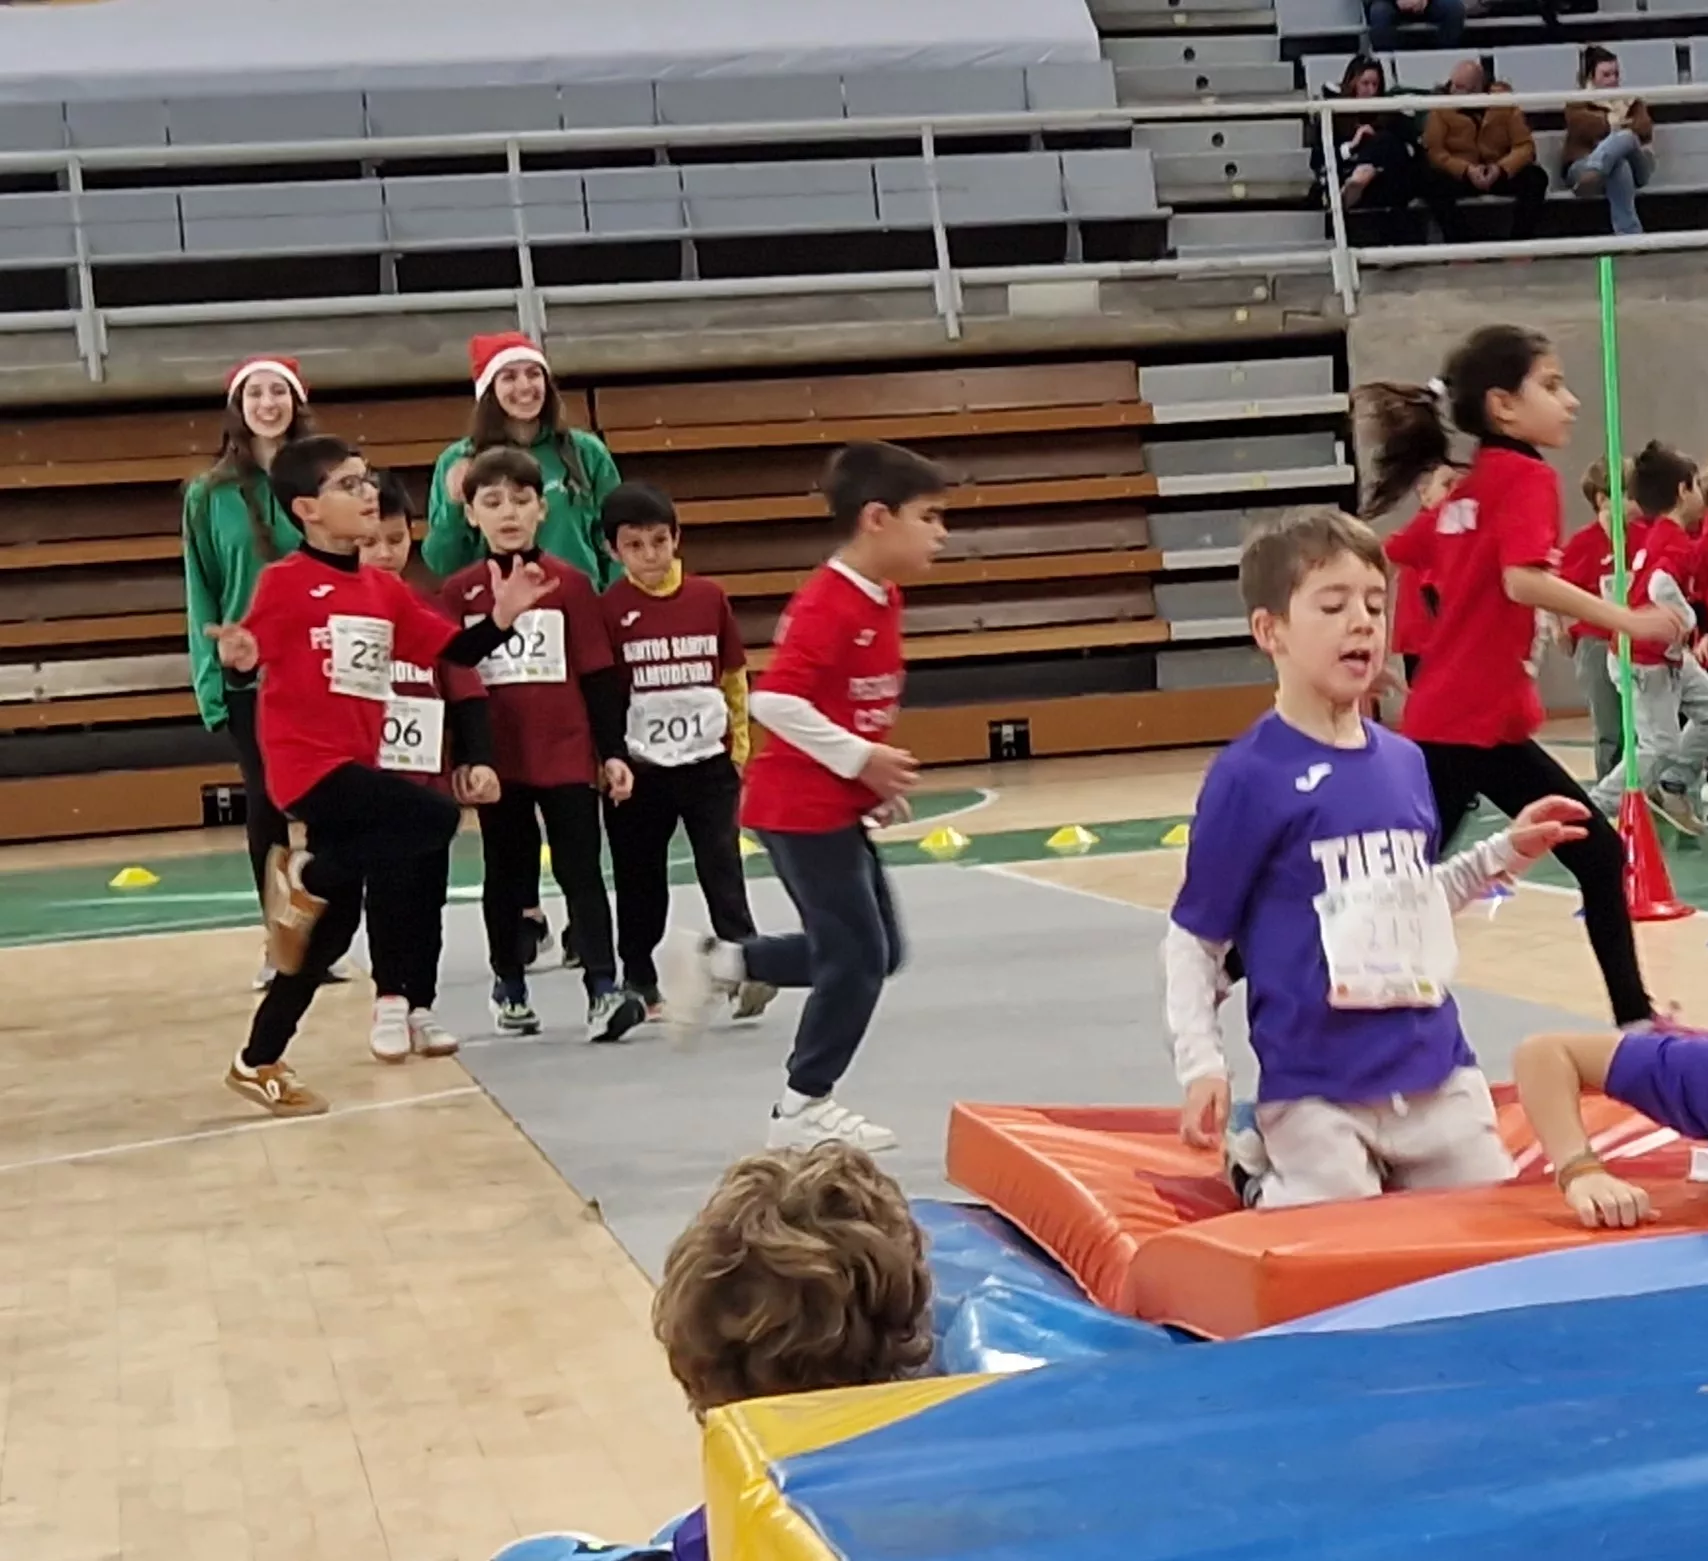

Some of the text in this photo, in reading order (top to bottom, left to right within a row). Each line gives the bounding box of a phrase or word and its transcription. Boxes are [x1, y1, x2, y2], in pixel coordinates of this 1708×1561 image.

[489, 631, 547, 659] 02
[381, 716, 422, 747] 06
[647, 713, 704, 744] 201
